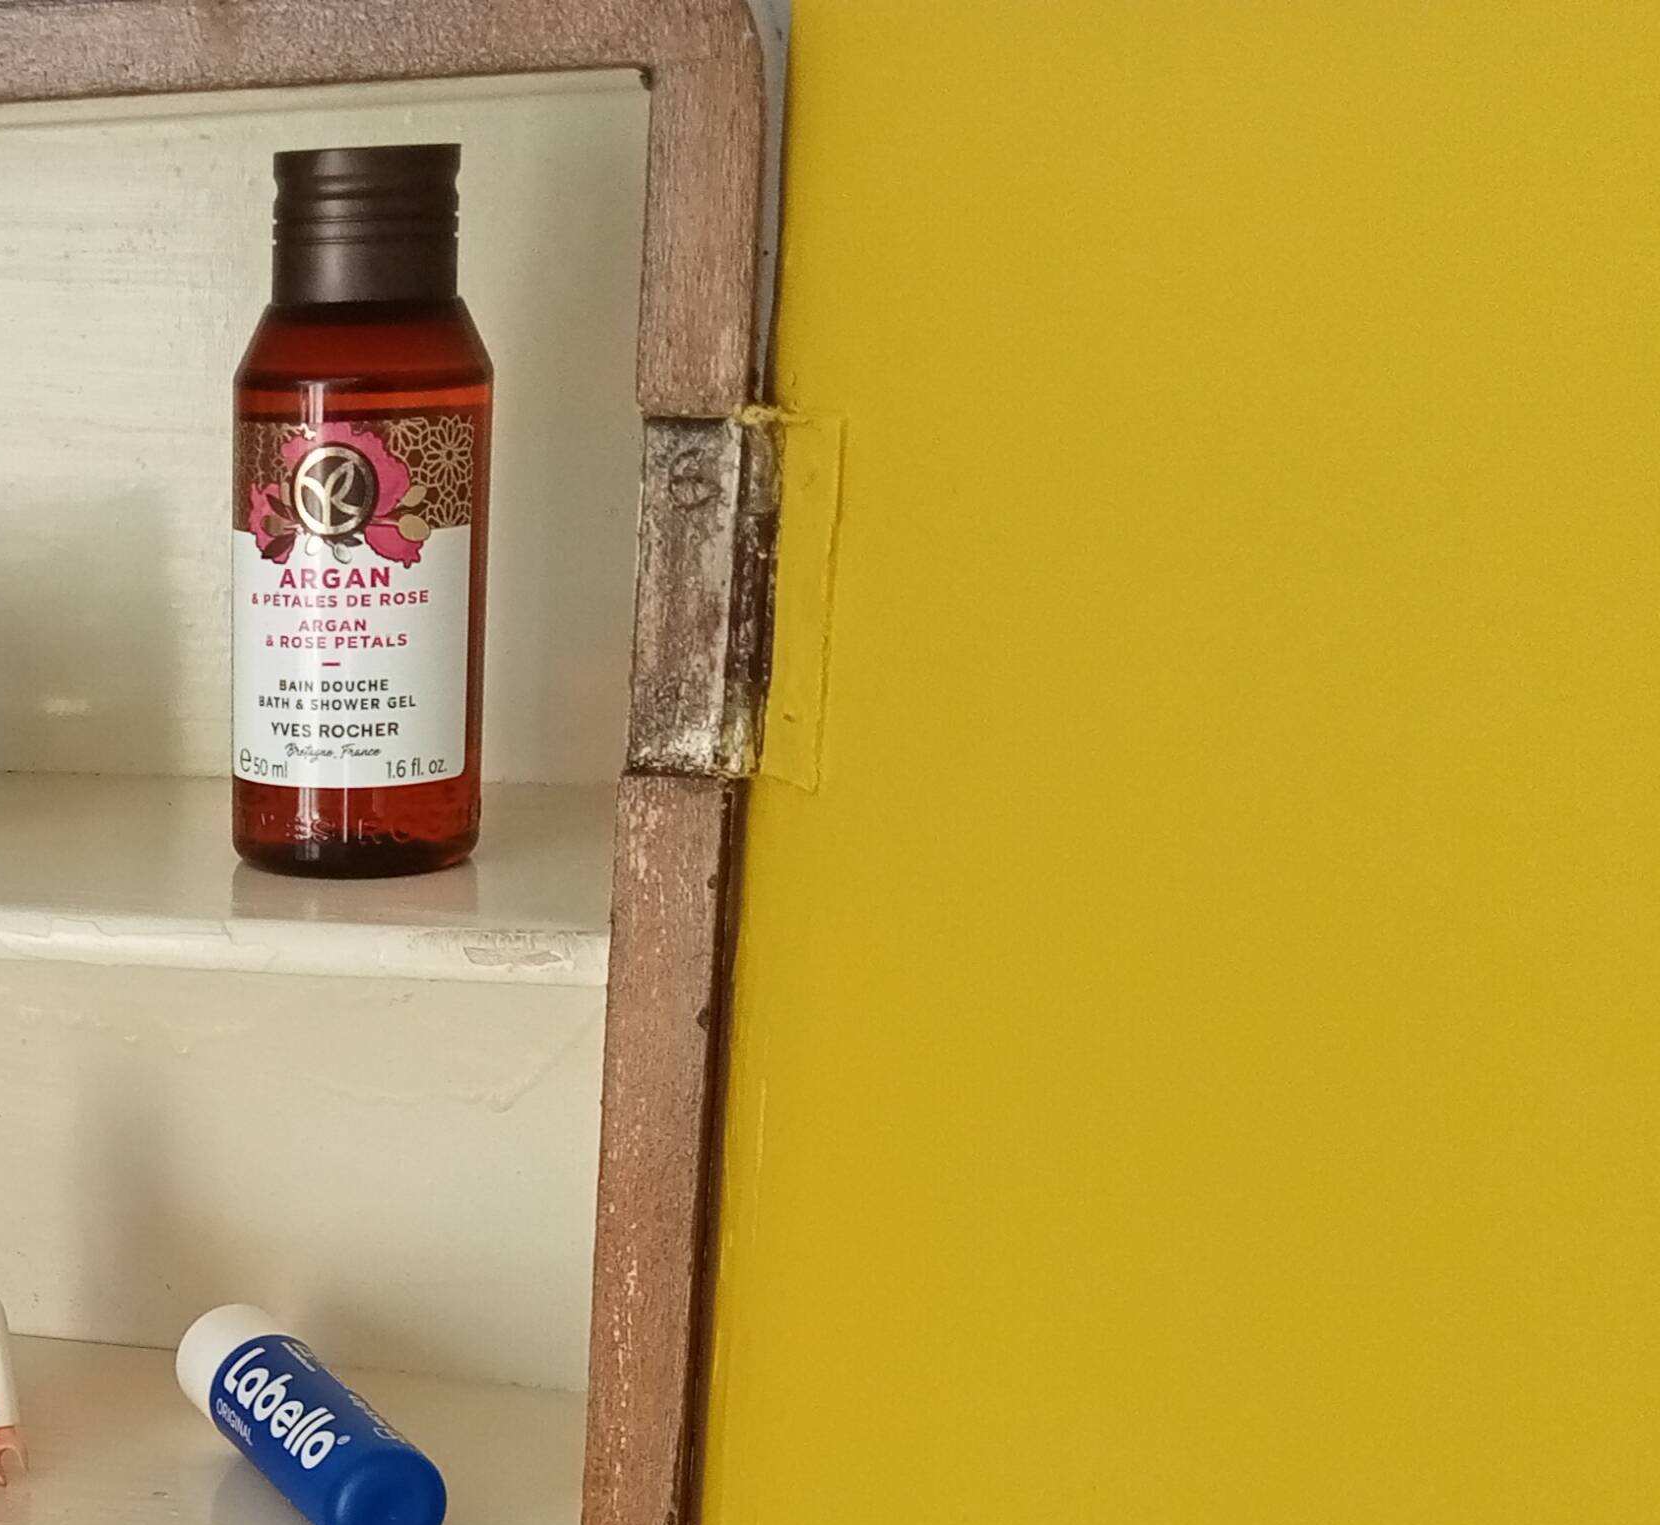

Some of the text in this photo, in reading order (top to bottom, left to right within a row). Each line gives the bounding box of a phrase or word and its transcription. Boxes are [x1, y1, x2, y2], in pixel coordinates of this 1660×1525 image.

[279, 567, 391, 589] ARGAN
[251, 593, 259, 604] &
[346, 594, 371, 607] DE
[380, 590, 429, 606] ROSE
[298, 619, 367, 632] ARGAN
[266, 633, 408, 649] & ROSE PETALS
[279, 679, 389, 692] BAIN DOUCHE
[259, 695, 417, 711] BATH & SHOWER GEL
[271, 721, 400, 739] YVES ROCHER
[341, 743, 382, 760] France
[254, 758, 268, 777] 50
[272, 760, 288, 778] ml
[385, 757, 448, 779] 1.6 fl. oz.
[215, 1397, 253, 1447] ORIGINAL
